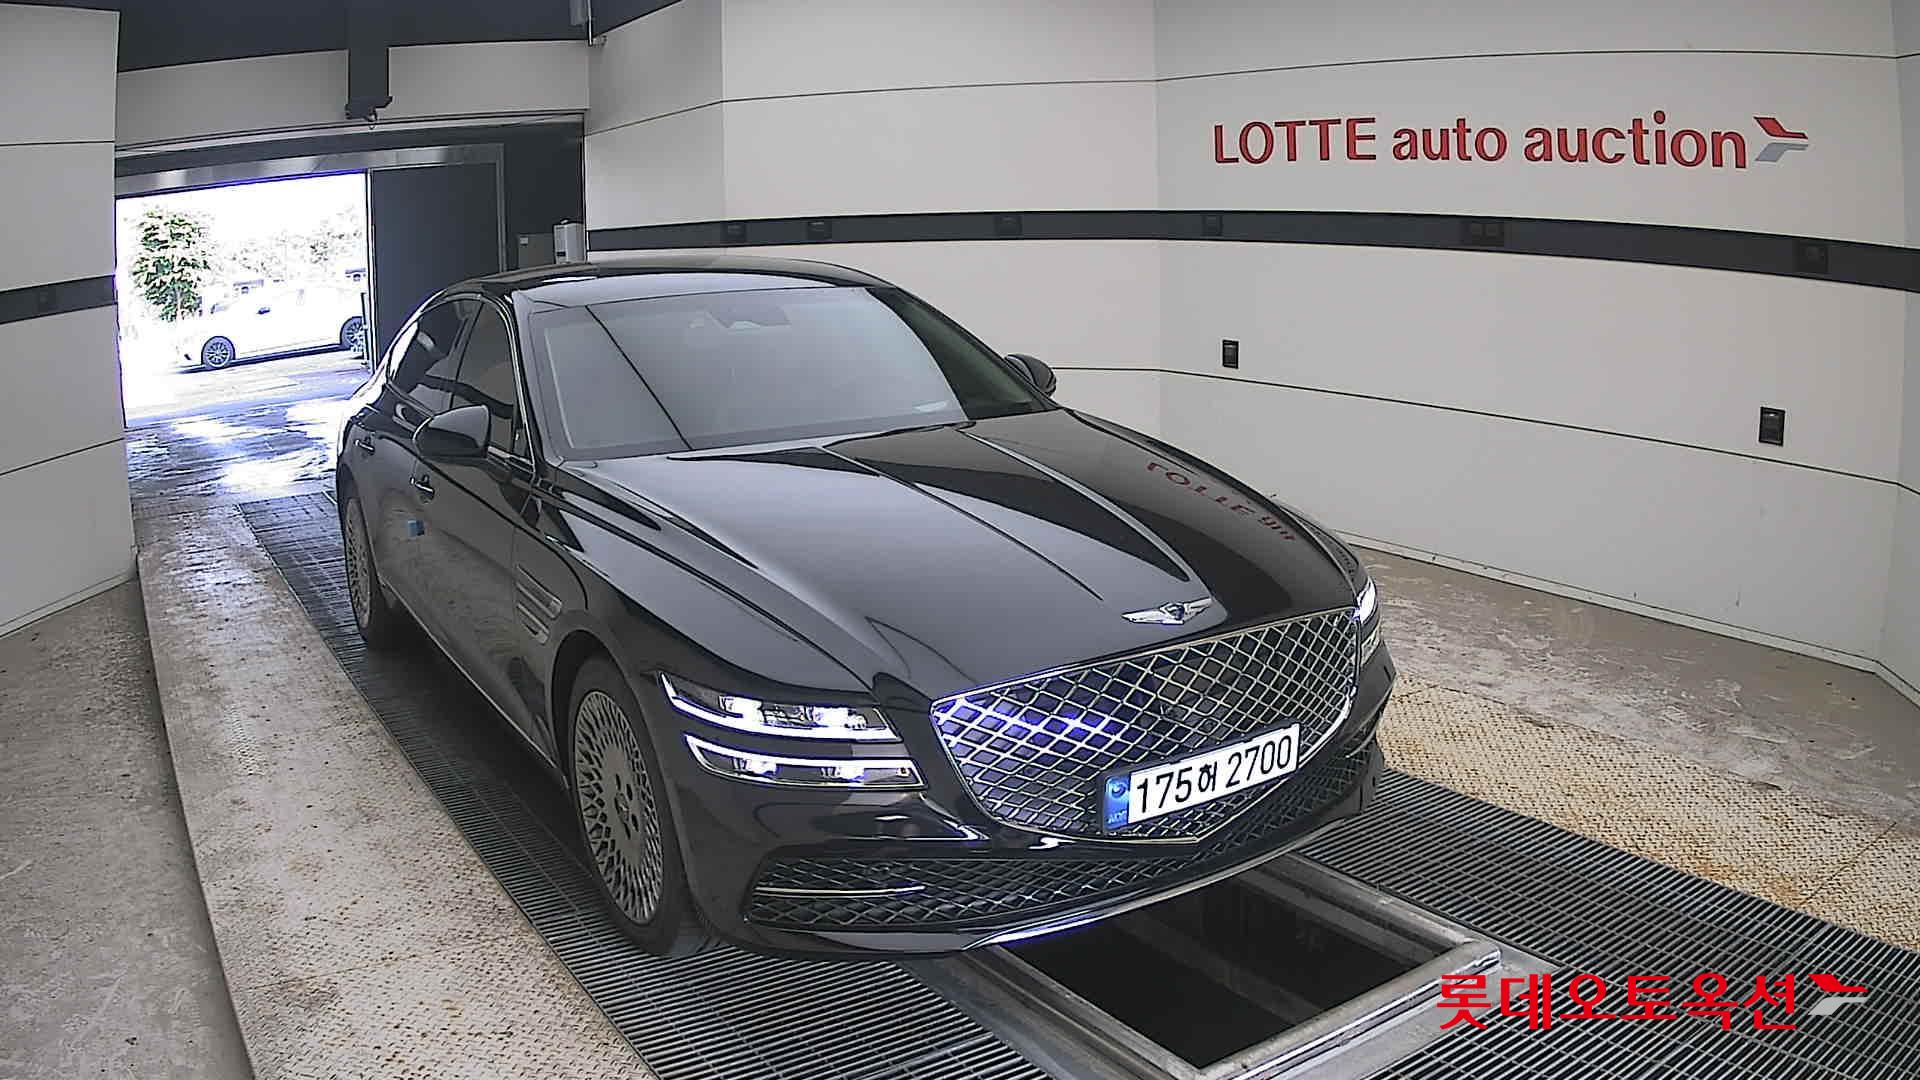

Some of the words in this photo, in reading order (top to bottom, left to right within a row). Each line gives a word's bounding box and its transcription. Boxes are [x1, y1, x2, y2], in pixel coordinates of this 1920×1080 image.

[1213, 116, 1377, 165] LOTTE
[1392, 117, 1509, 163] auto
[1522, 109, 1748, 169] auction
[1136, 761, 1218, 814] 175허
[1225, 735, 1292, 788] 2700
